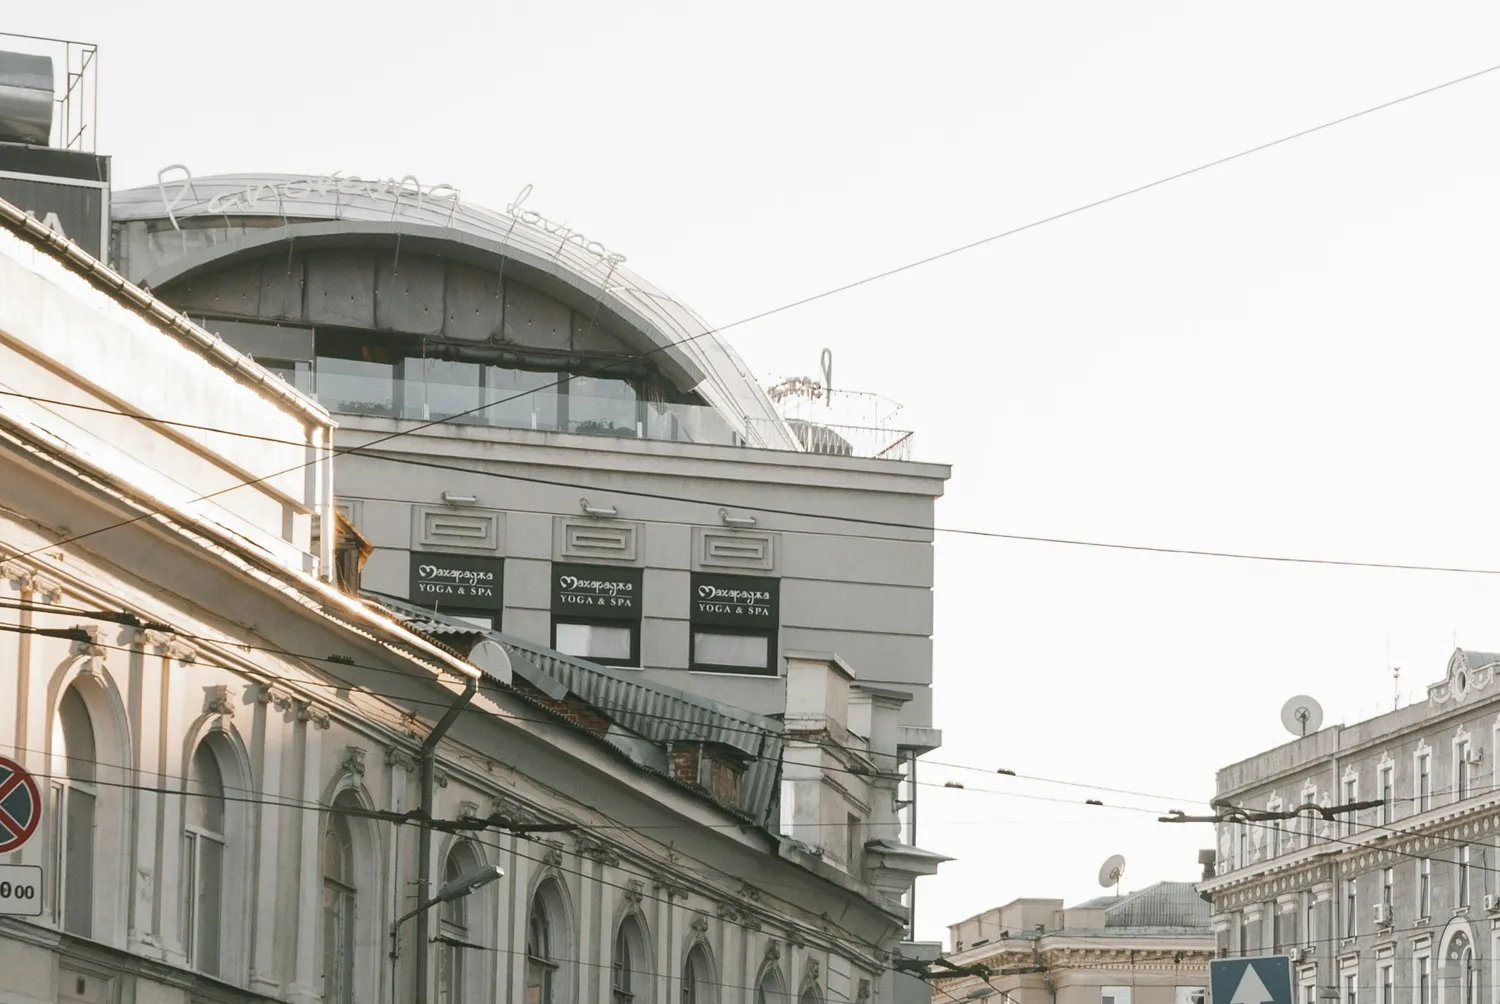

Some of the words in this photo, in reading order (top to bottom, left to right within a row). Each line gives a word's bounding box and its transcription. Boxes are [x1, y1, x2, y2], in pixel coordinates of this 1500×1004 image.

[419, 565, 494, 585] Махараджа
[419, 583, 452, 594] YOGA
[457, 586, 466, 595] &
[470, 587, 493, 597] SPA
[560, 575, 633, 595] Махараджа
[560, 595, 593, 606] YOGA
[598, 597, 606, 606] &
[610, 598, 632, 608] SPA
[698, 585, 770, 605] Махараджа
[699, 604, 731, 615] YOGA
[735, 607, 743, 615] &
[748, 607, 769, 617] SPA
